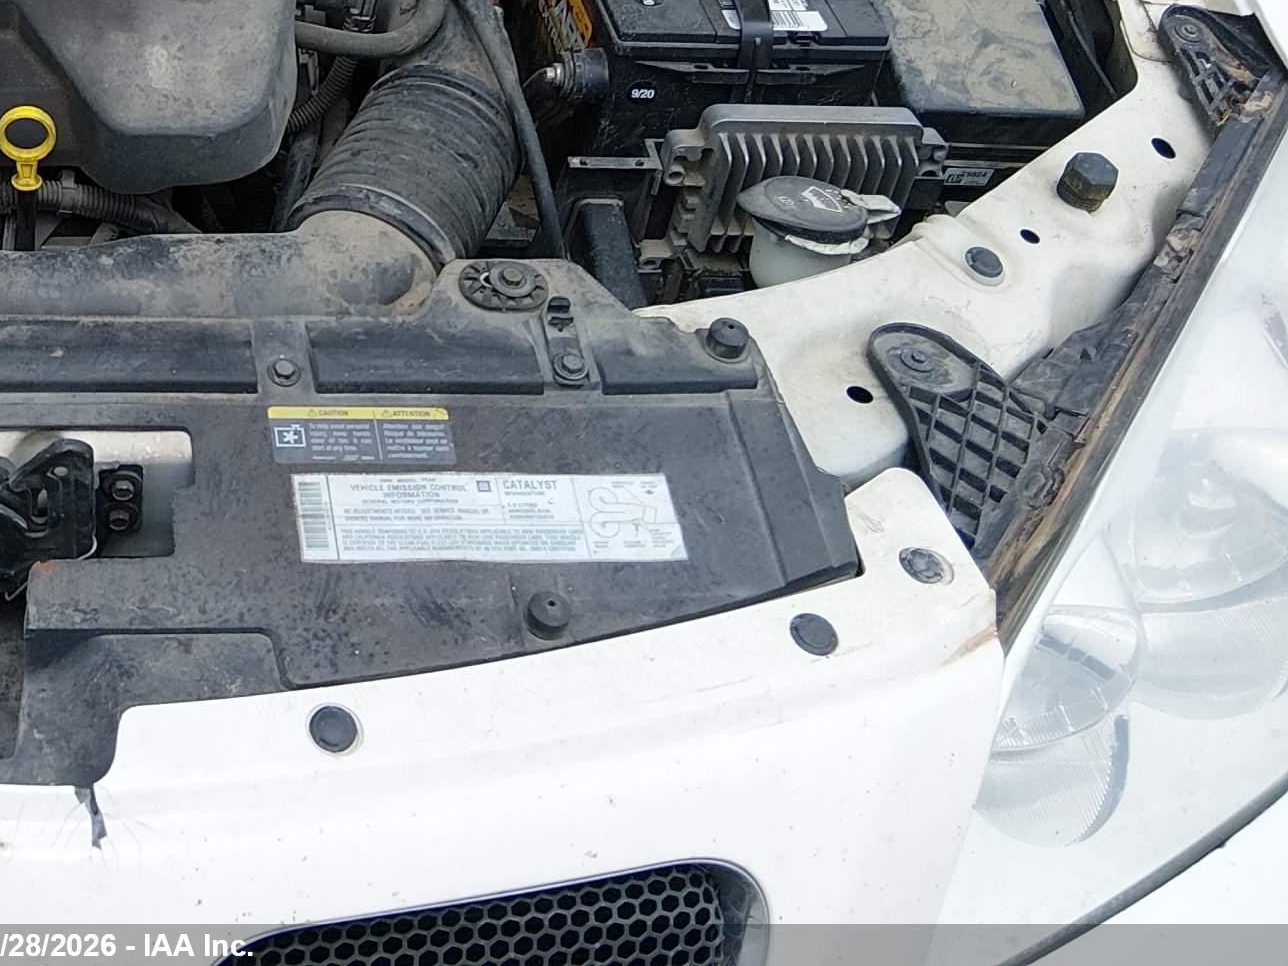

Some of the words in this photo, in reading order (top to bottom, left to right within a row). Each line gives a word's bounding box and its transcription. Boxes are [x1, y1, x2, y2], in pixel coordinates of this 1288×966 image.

[632, 88, 655, 99] 9/20
[387, 484, 427, 492] EMISSION
[430, 484, 468, 492] CONTROL
[503, 480, 558, 490] CATALYST
